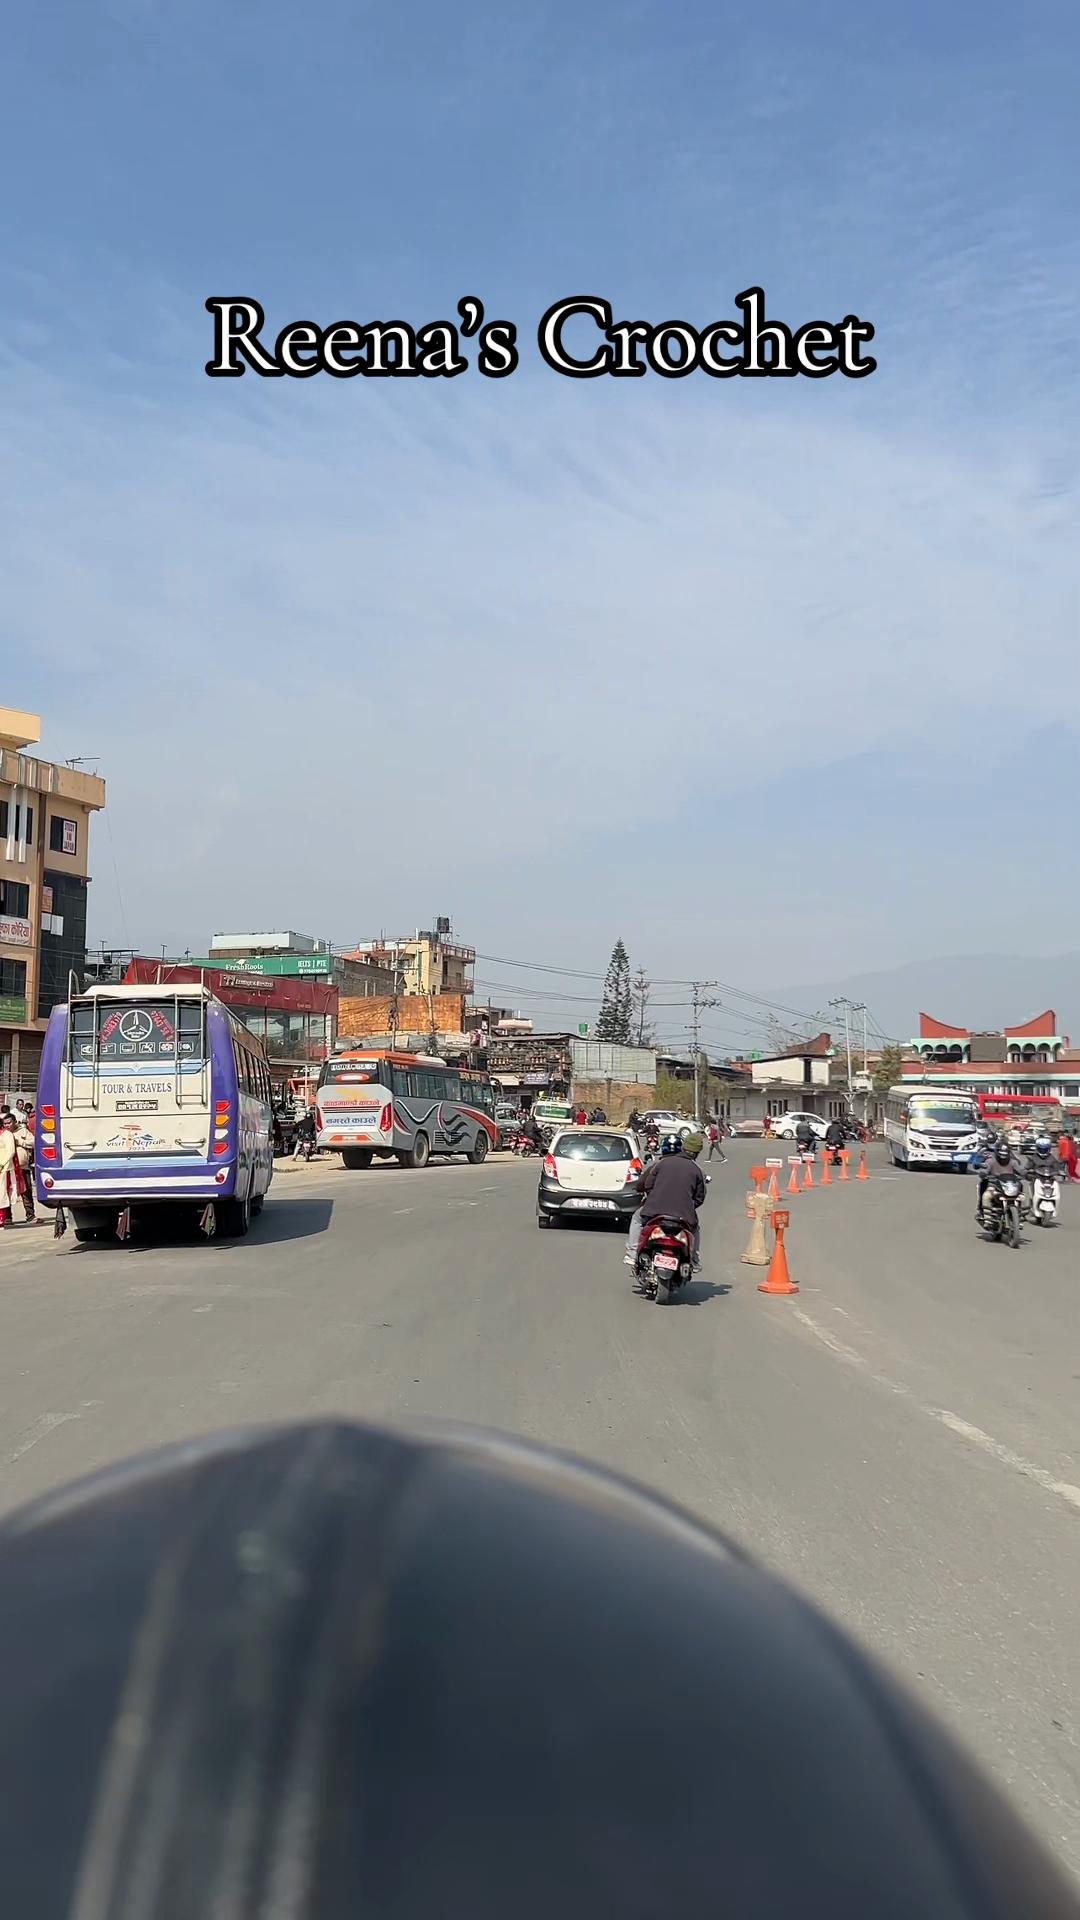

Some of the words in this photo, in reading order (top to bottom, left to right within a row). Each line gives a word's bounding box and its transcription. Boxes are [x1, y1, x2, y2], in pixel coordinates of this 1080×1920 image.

[102, 1083, 125, 1094] TOUR
[127, 1083, 133, 1093] &
[135, 1082, 173, 1094] TRAVELS
